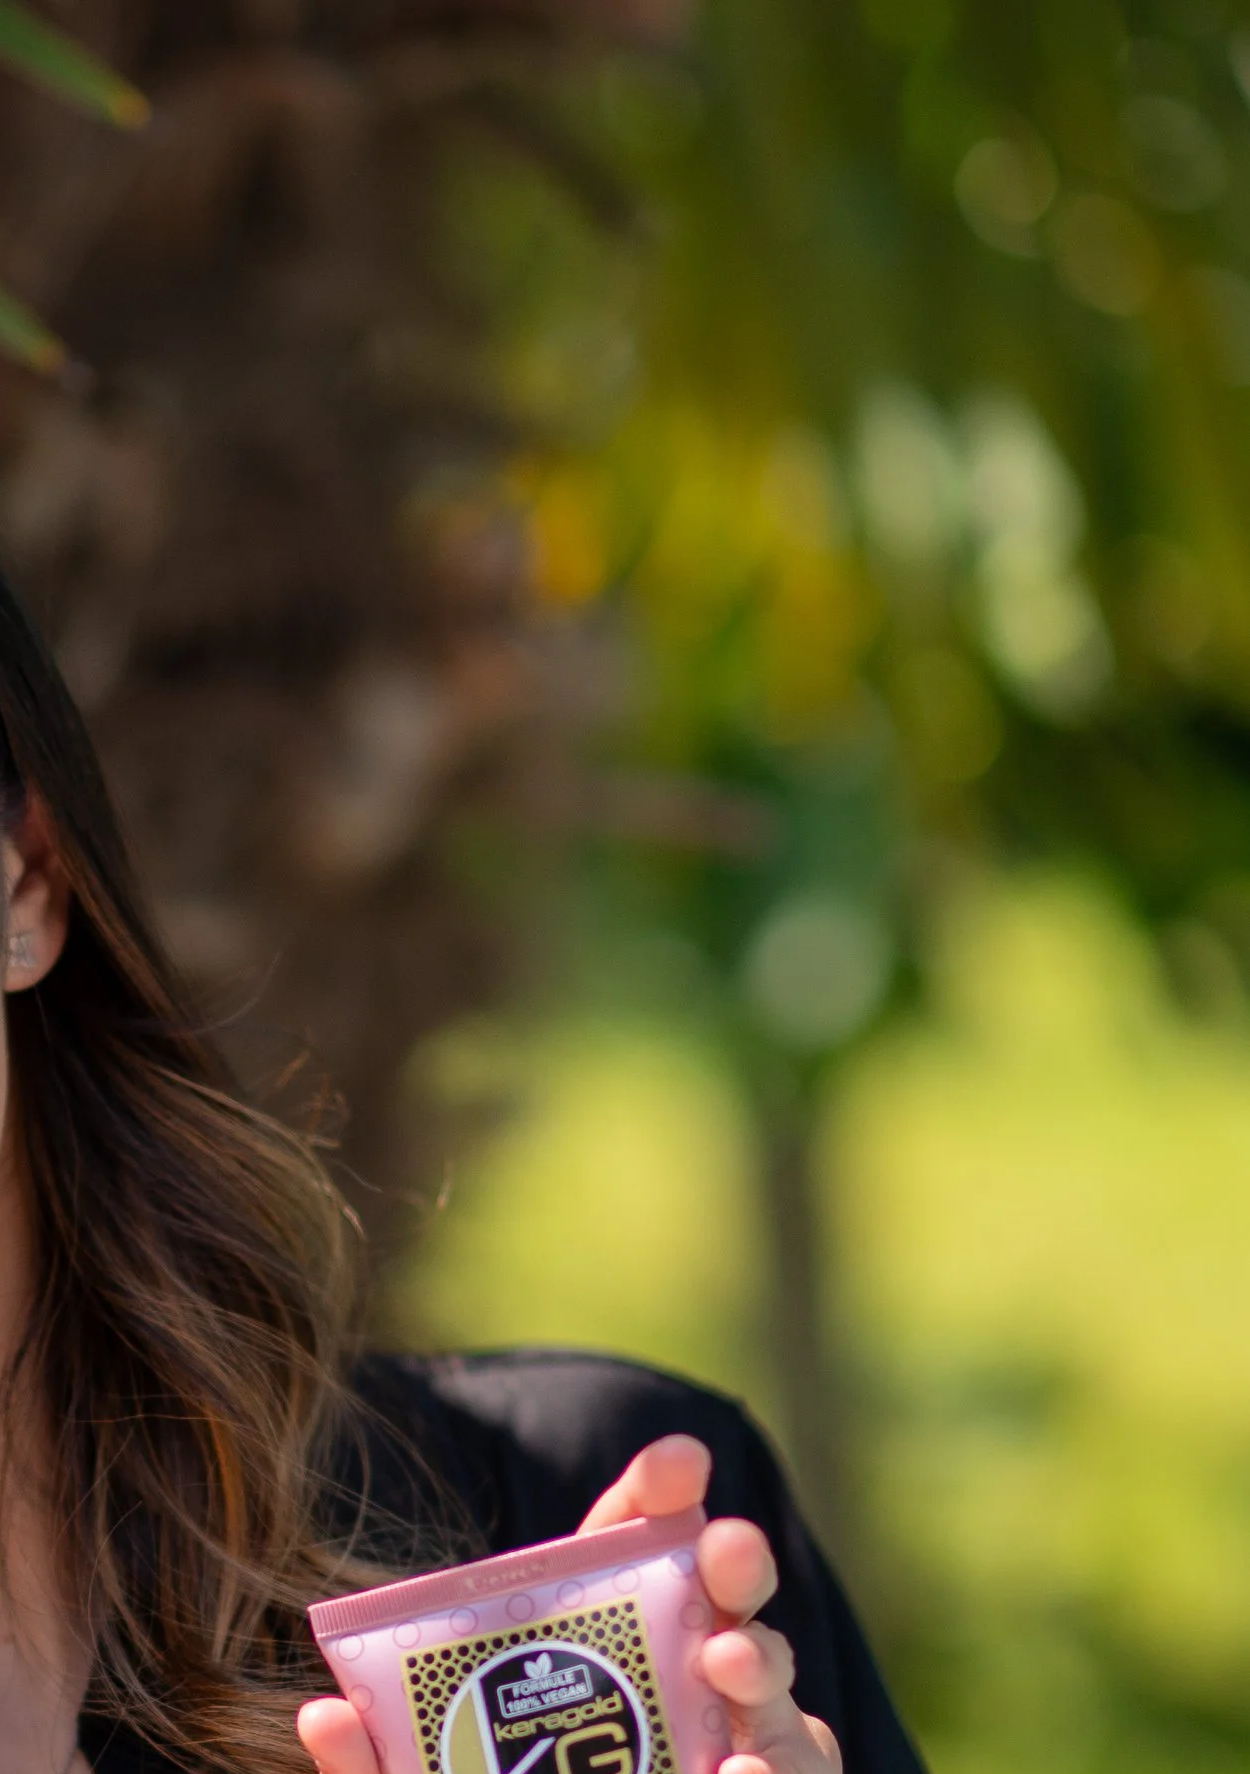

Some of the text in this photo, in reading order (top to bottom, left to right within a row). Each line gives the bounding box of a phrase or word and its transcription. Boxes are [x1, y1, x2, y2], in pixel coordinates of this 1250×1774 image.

[506, 1683, 587, 1713] 100% VEGAN
[512, 1671, 576, 1699] FORMULE
[493, 1691, 624, 1743] keragold
